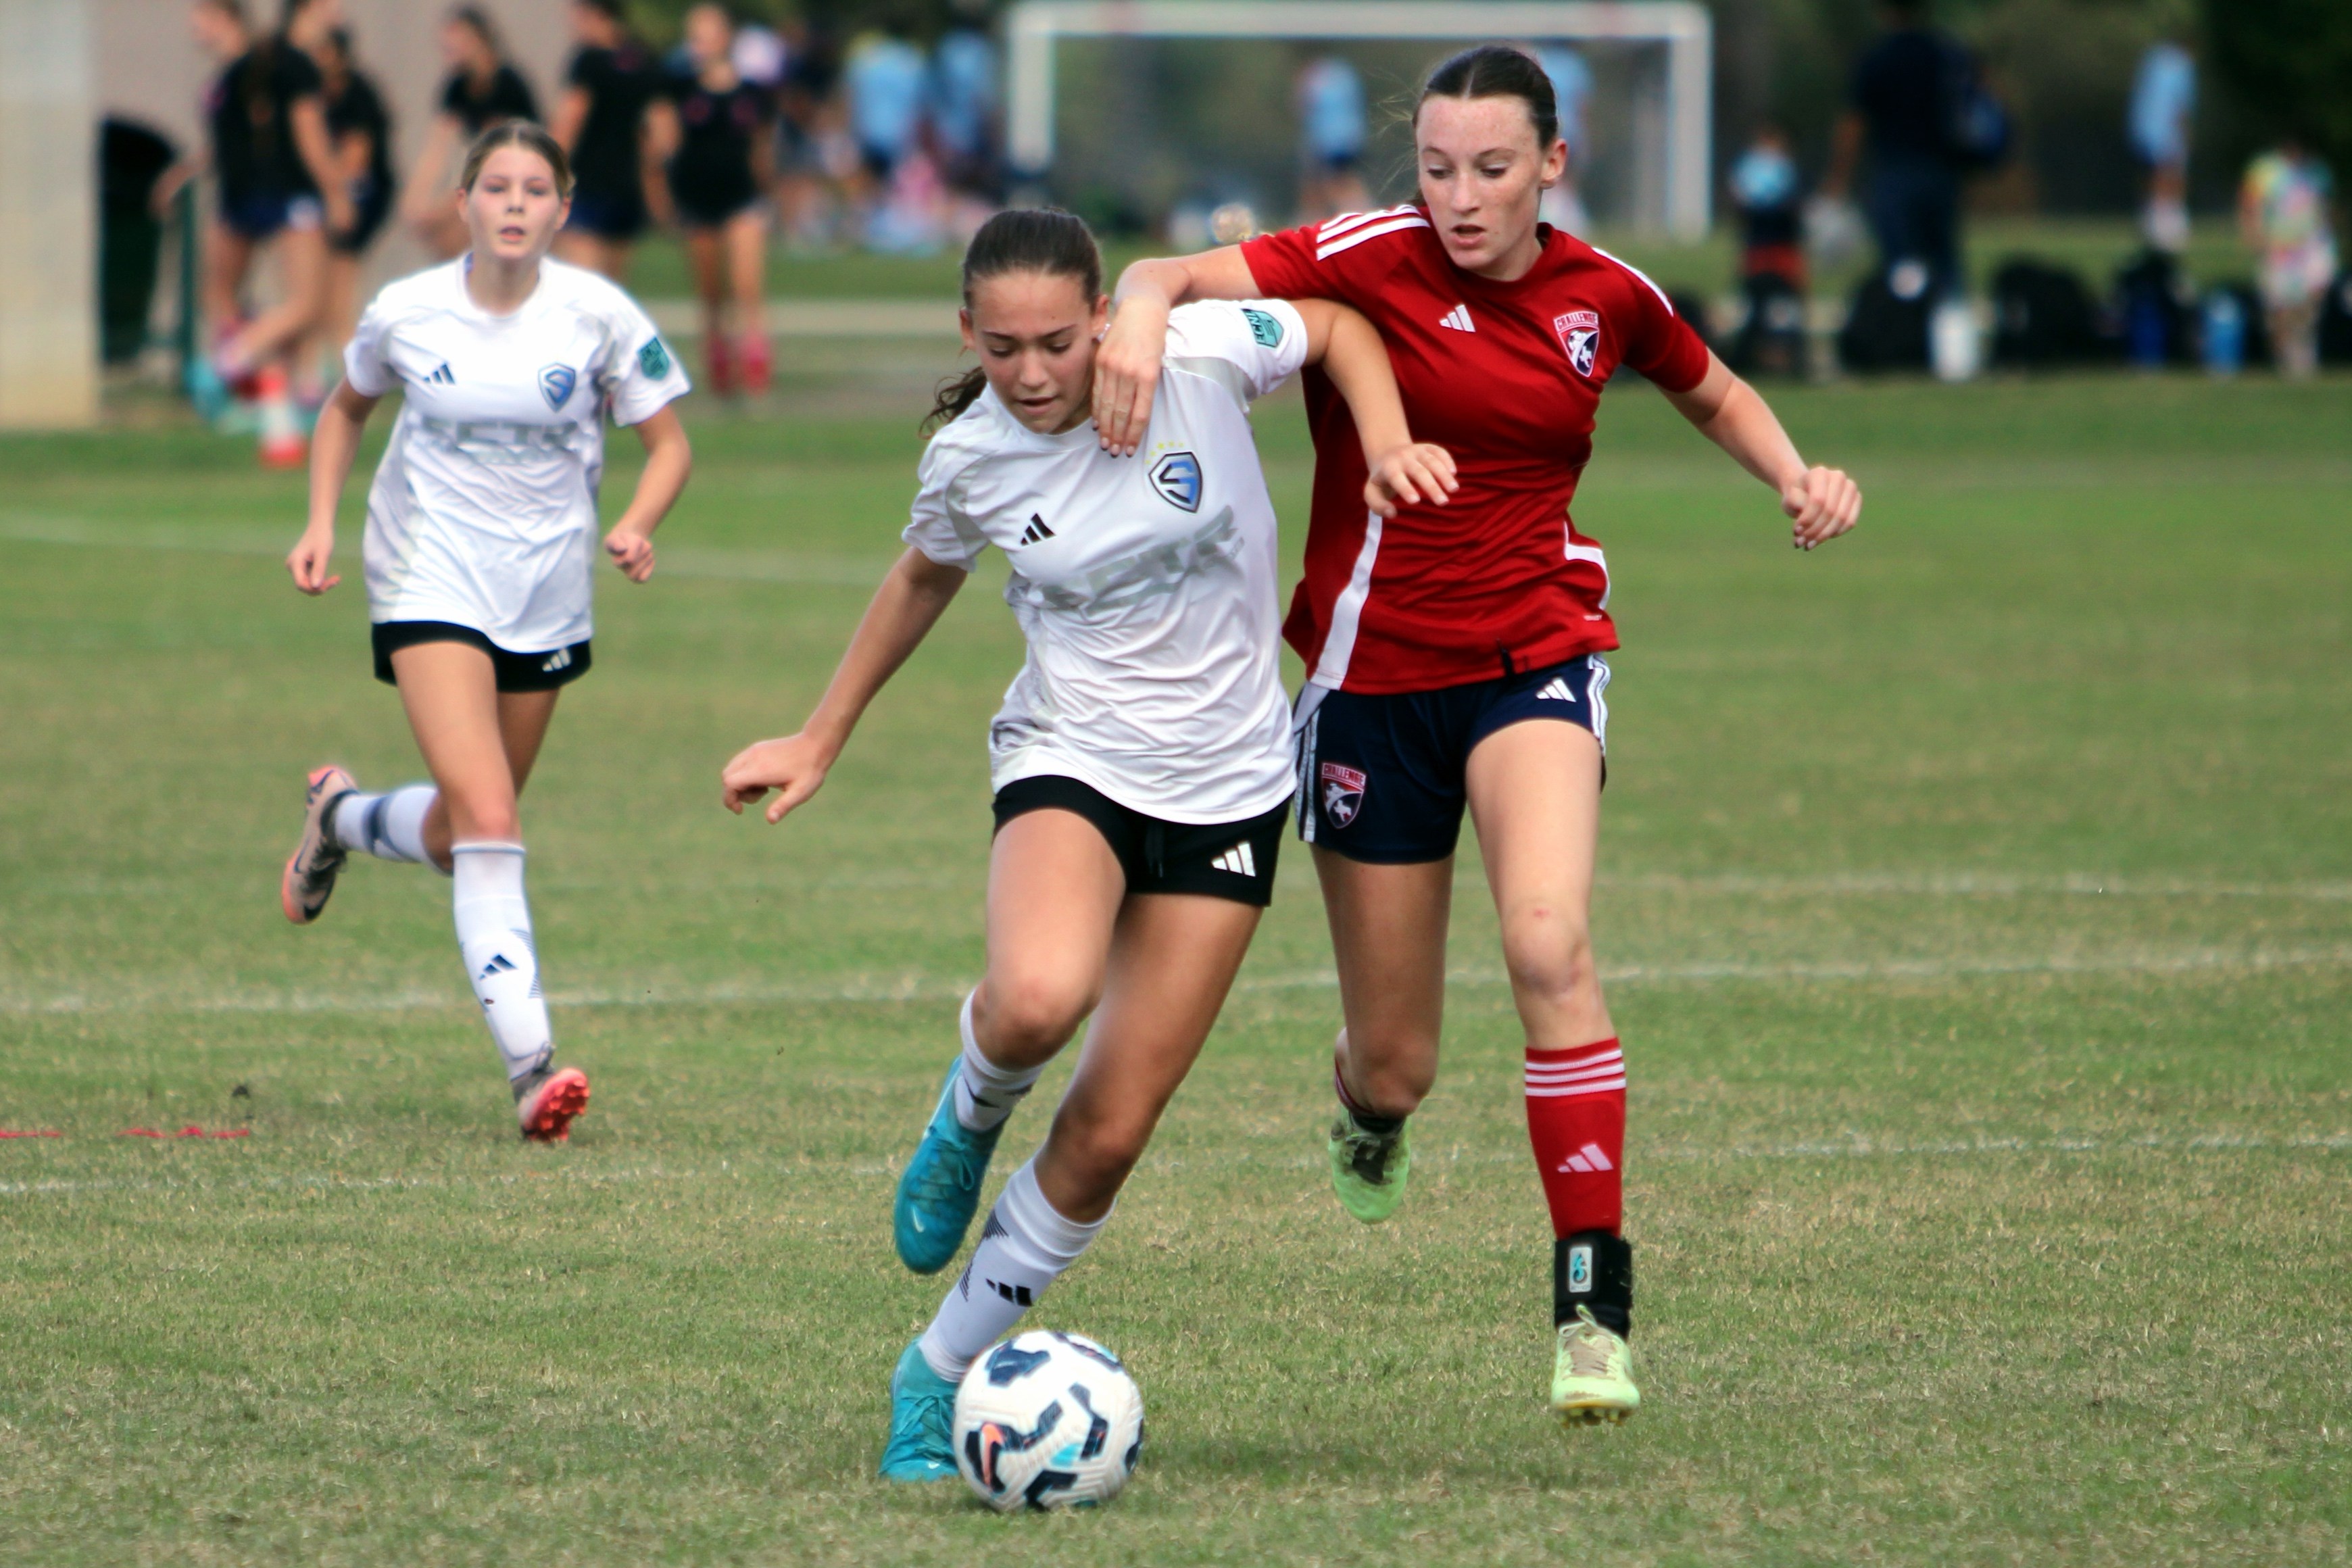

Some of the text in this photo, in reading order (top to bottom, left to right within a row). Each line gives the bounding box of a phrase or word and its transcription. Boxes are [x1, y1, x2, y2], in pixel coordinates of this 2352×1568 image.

[1245, 312, 1265, 343] ECNL
[1556, 312, 1597, 330] CHALLENGE
[1324, 763, 1364, 785] CHALLENGE
